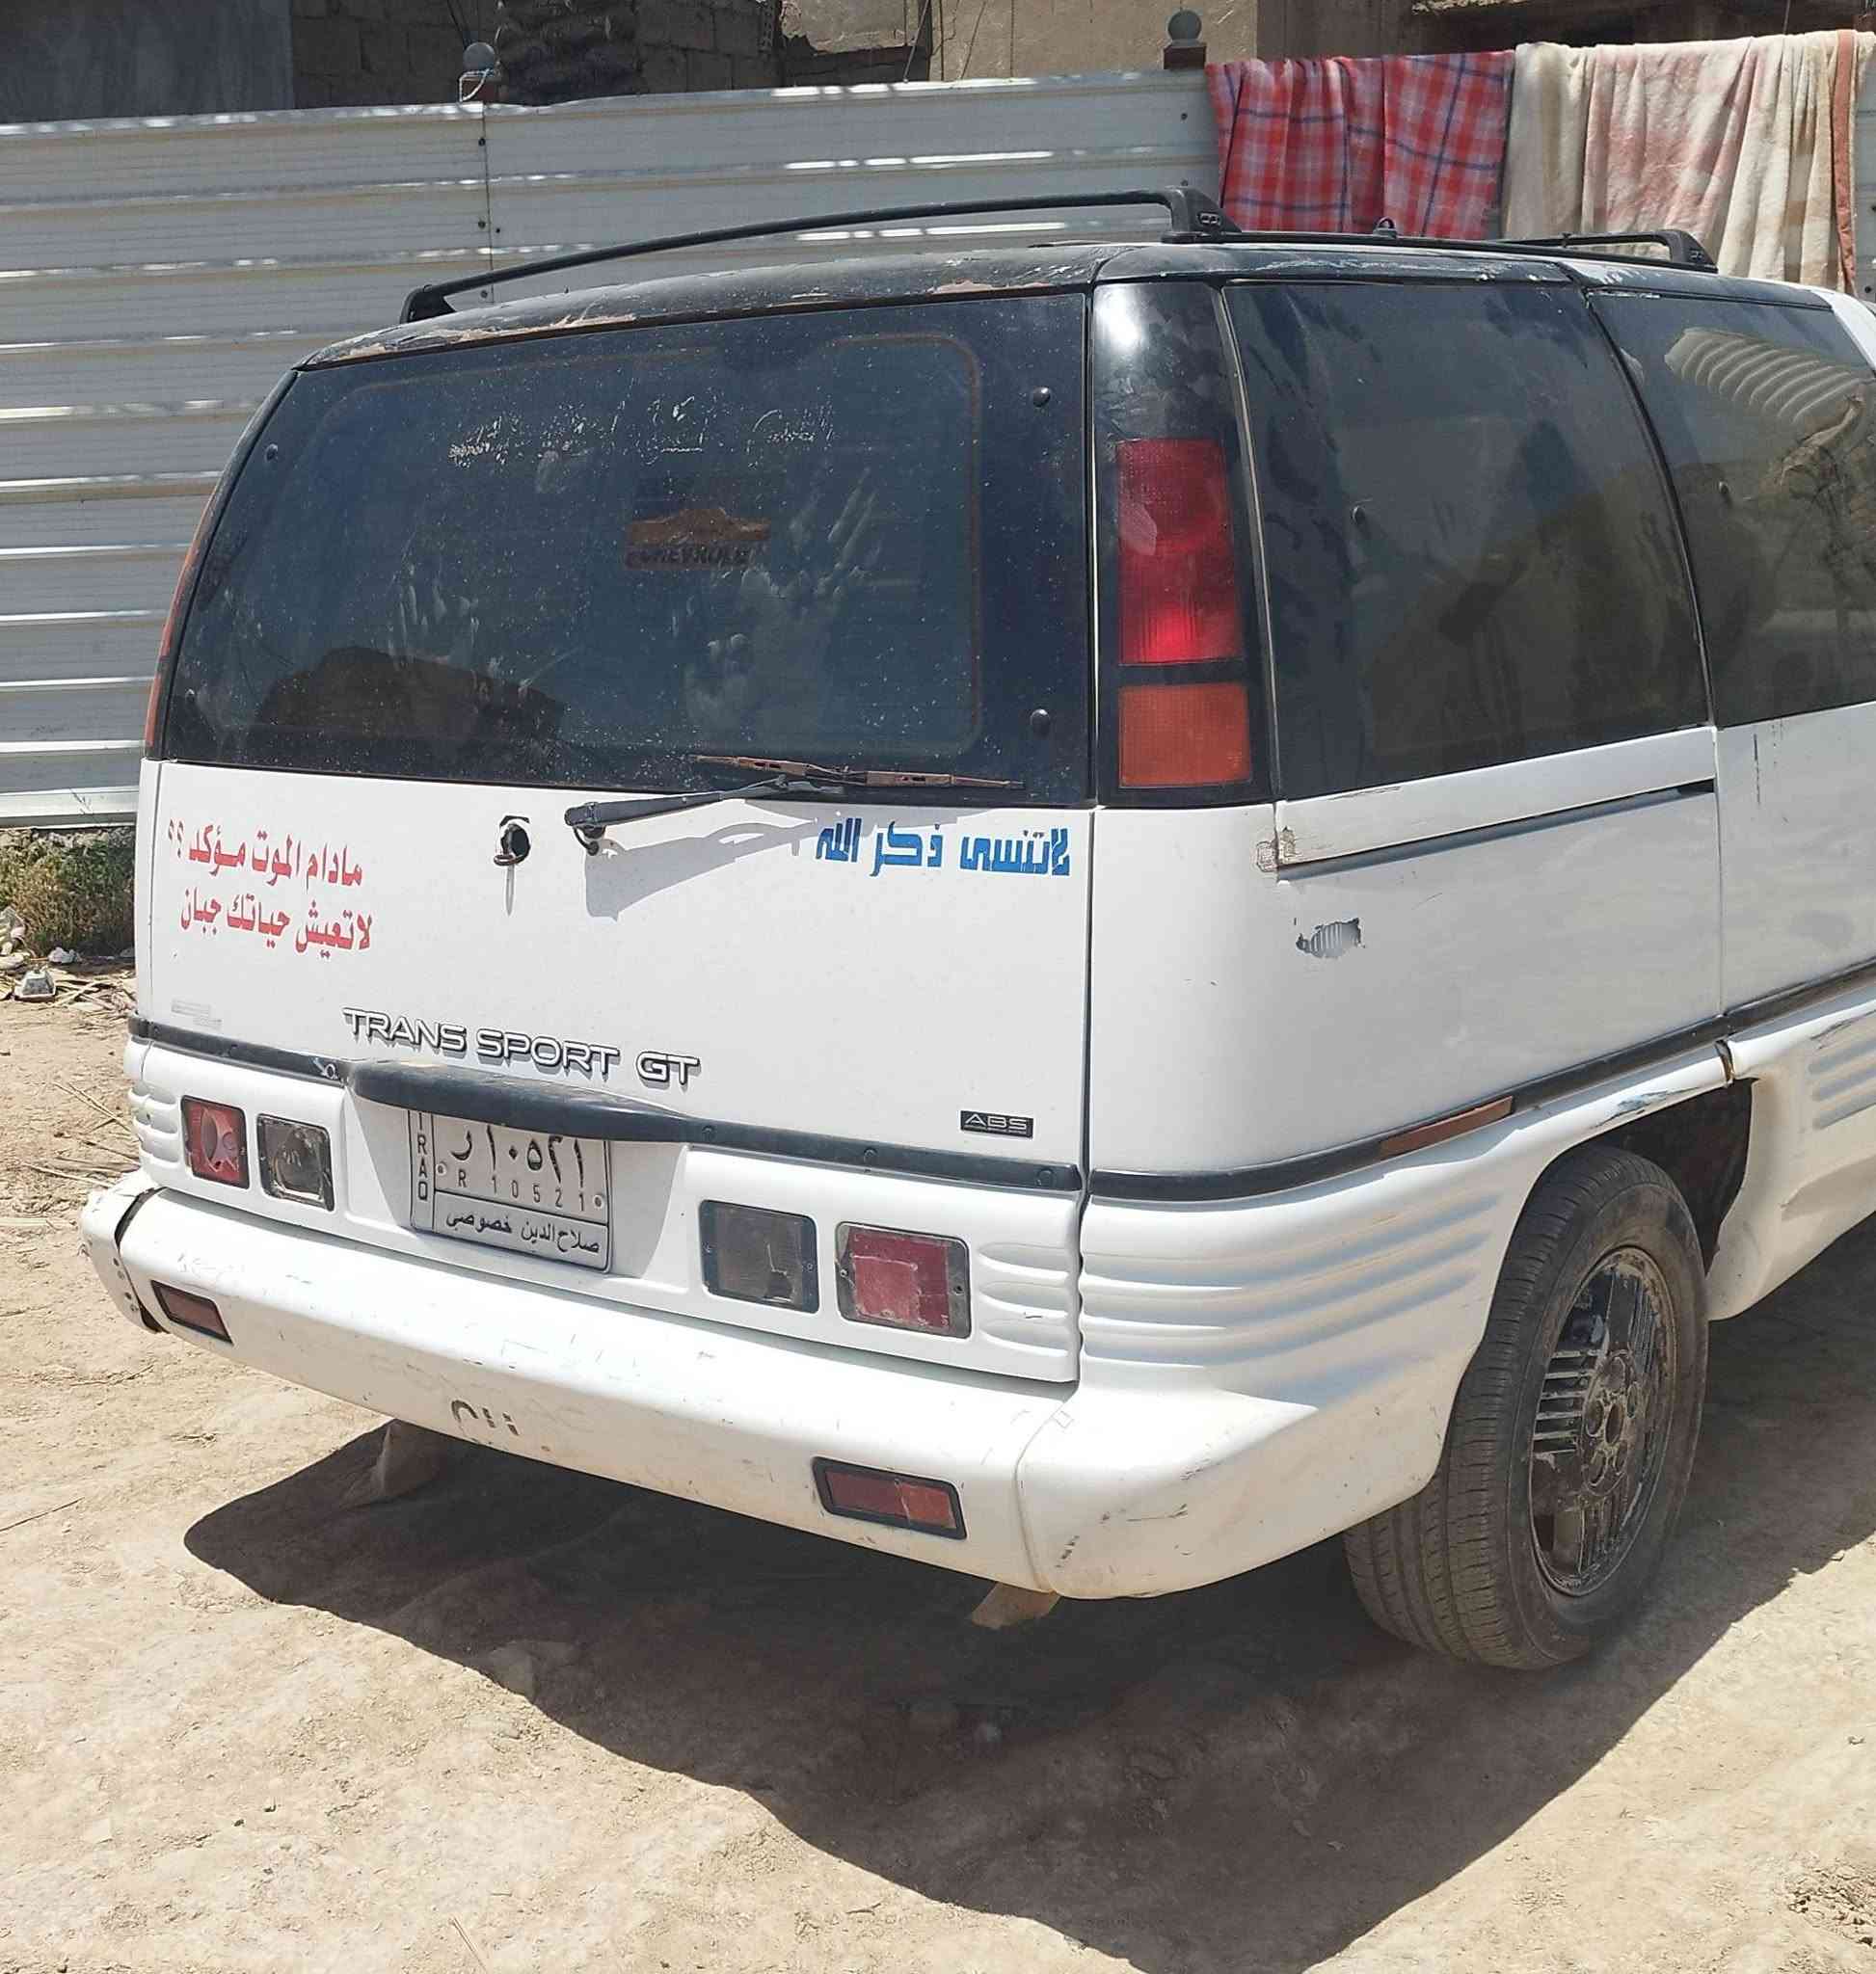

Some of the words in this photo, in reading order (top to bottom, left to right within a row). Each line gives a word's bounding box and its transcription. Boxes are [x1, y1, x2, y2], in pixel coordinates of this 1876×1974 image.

[252, 831, 301, 886] الموت
[307, 840, 362, 894] مادام
[816, 817, 862, 863] الله
[870, 820, 944, 876] ذكر
[180, 887, 222, 934] جبان
[227, 894, 290, 948] حياتك
[342, 1006, 467, 1054] TRANS
[475, 1027, 620, 1075] SPORT
[636, 1049, 700, 1086] GT
[965, 1113, 1027, 1131] ABS
[416, 1112, 429, 1201] IRAQ
